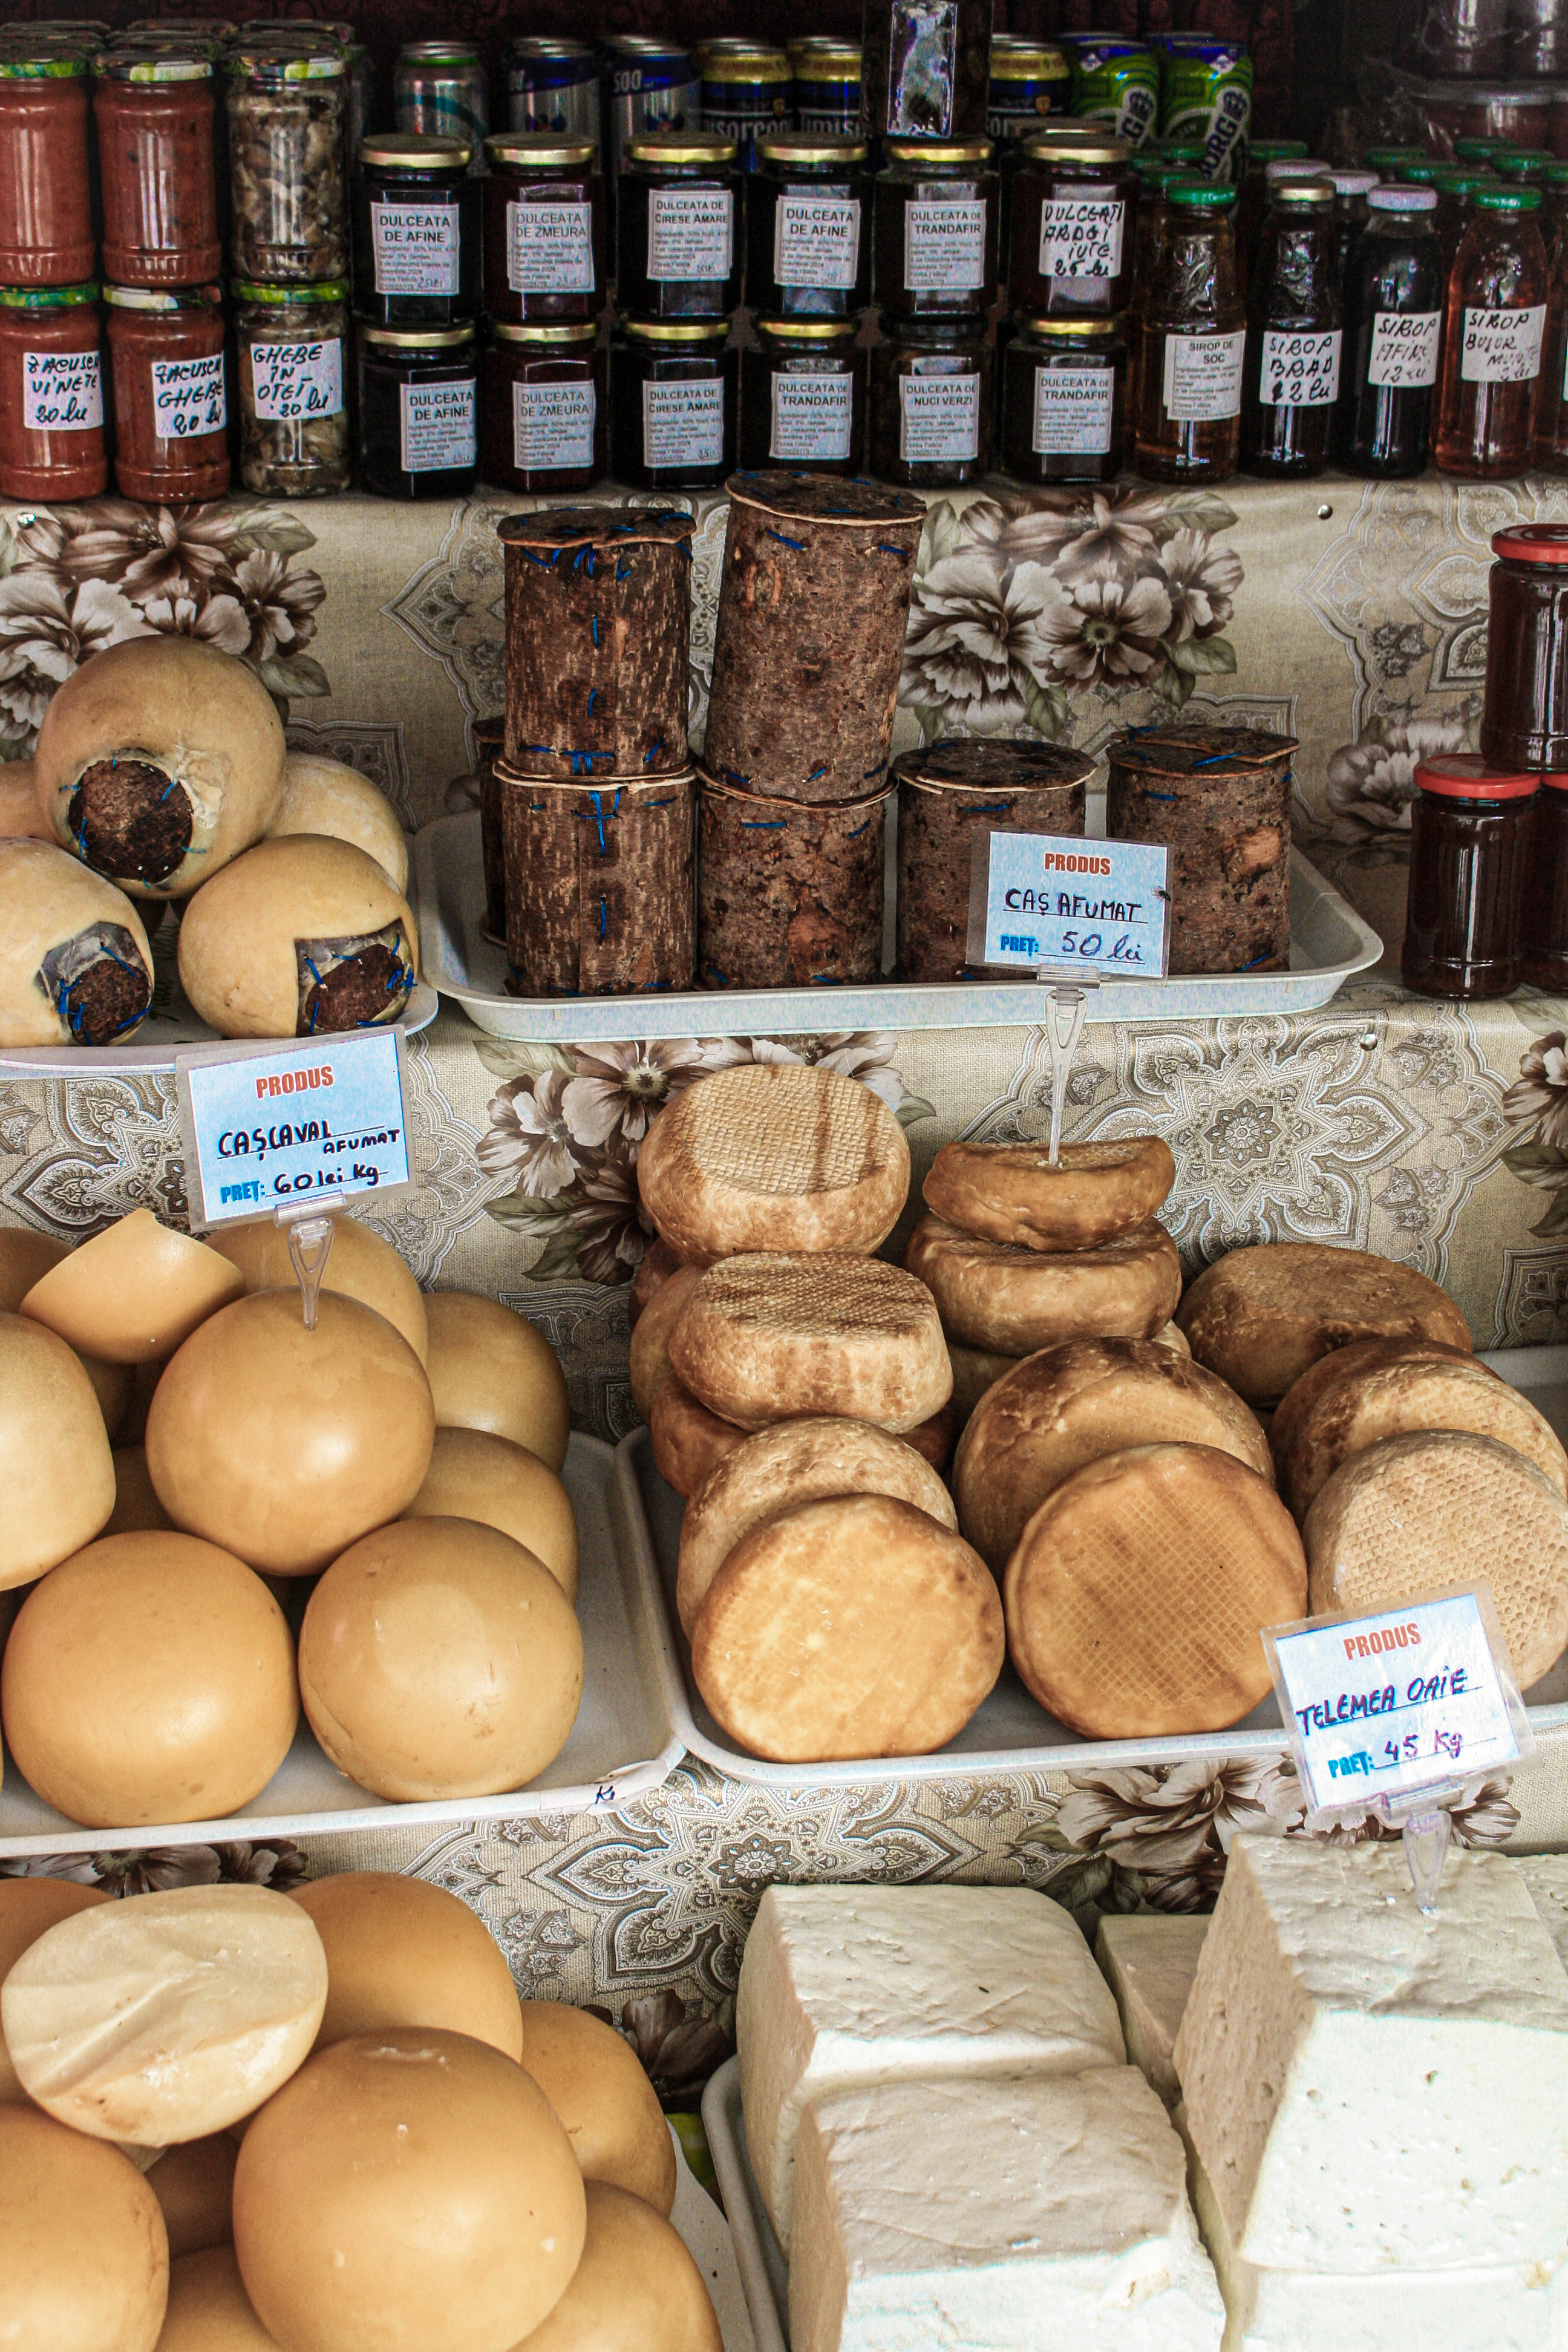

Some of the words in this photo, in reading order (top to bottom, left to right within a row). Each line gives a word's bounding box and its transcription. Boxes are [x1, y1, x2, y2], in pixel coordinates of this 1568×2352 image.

[656, 201, 708, 210] DULCEATA
[711, 200, 725, 210] DE
[380, 216, 451, 227] DULCEATA
[517, 213, 582, 224] DULCEATA
[655, 214, 691, 224] CIRESE
[693, 214, 728, 224] AMARE
[786, 209, 853, 222] DULCEATA
[911, 212, 969, 221] DULCEATA
[516, 227, 532, 238] DE
[535, 227, 586, 238] ZMEURA
[790, 224, 807, 235] DE
[812, 224, 848, 237] AFINE
[915, 224, 981, 234] TRANDAFIR
[385, 231, 402, 241] DE
[407, 231, 445, 243] AFINE
[1469, 312, 1529, 330] SIROP
[1378, 318, 1436, 337] SIROP
[1189, 342, 1221, 351] SIROP
[1223, 341, 1233, 350] DE
[1270, 336, 1332, 356] SIROP
[253, 344, 322, 364] GHEBE
[1382, 365, 1402, 383] 12
[779, 384, 835, 393] DULCEATA
[907, 385, 962, 393] DULCEATA
[1041, 378, 1096, 388] DULCEATA
[410, 390, 474, 406] DULCEATA
[522, 392, 585, 403] DULCEATA
[650, 390, 702, 400] DULCEATA
[704, 389, 717, 397] DE
[1044, 391, 1108, 400] TRANDAFIR
[782, 396, 847, 406] TRANDAFIR
[915, 397, 939, 406] NUCI
[942, 397, 973, 405] VERZI
[279, 403, 301, 417] 20
[415, 410, 431, 420] DE
[435, 407, 469, 419] AFINE
[521, 407, 535, 417] DE
[540, 405, 590, 416] ZMEURA
[649, 403, 684, 413] CIRESE
[1045, 853, 1111, 875] PRODUS
[1057, 892, 1143, 921] AFUMAT
[1062, 930, 1102, 956] 50
[1107, 934, 1143, 961] lei
[256, 1066, 335, 1099] PRODUS
[323, 1129, 400, 1154] AFUMAT
[274, 1173, 313, 1194] 60
[318, 1168, 343, 1186] lei
[1343, 1622, 1422, 1661] PRODUS
[1296, 1685, 1394, 1736] TELEMEA
[1406, 1665, 1468, 1702] OAIE
[1385, 1734, 1418, 1761] 45
